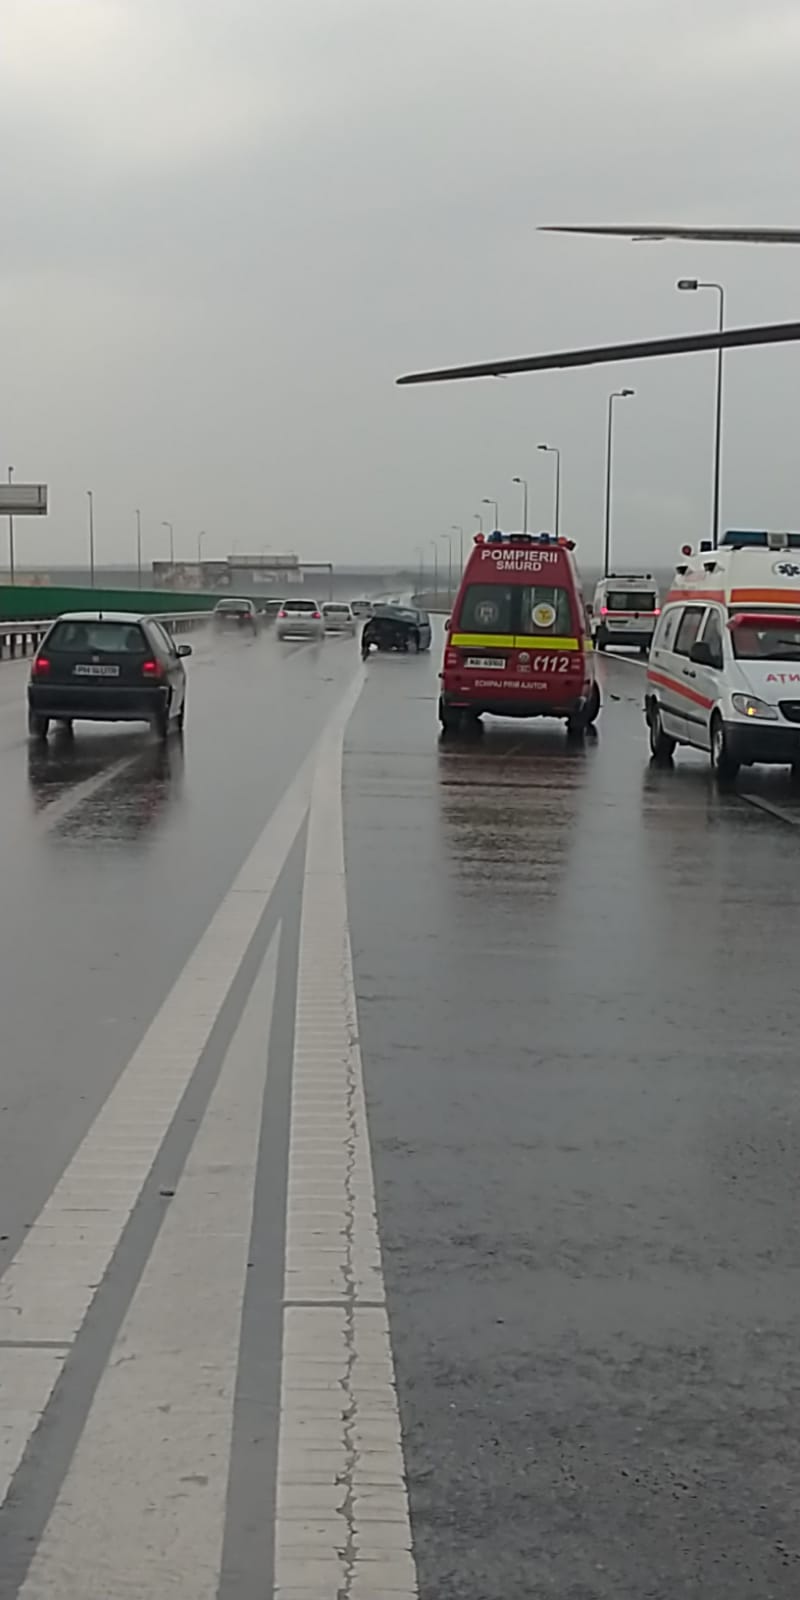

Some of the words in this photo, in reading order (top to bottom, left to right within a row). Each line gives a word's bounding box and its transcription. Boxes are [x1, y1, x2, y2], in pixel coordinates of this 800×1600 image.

[481, 549, 558, 563] POMPIERII
[496, 560, 542, 571] SMURD
[541, 656, 569, 672] 112
[520, 681, 548, 689] AJUTOR
